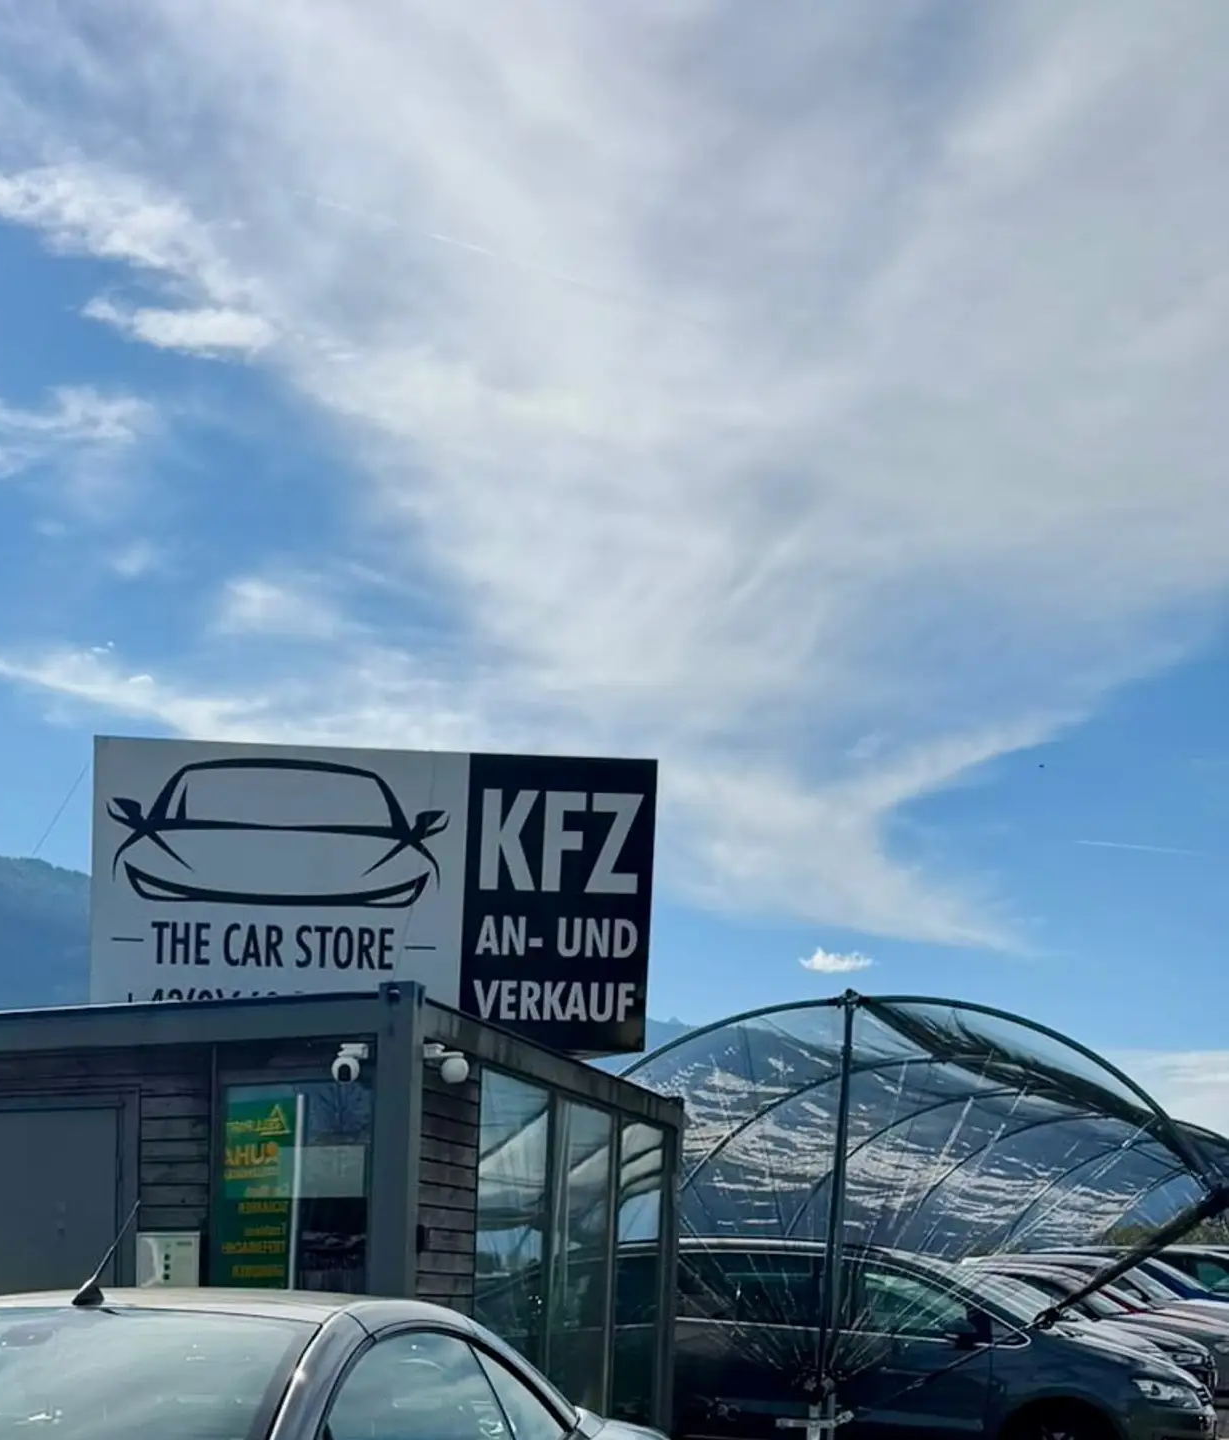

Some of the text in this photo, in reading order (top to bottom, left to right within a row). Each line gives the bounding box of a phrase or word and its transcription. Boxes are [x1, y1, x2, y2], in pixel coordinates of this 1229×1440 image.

[478, 788, 645, 895] KFZ
[151, 920, 395, 971] THE CAR STORE
[474, 914, 638, 959] AN- UND
[473, 979, 636, 1022] VERKAUF
